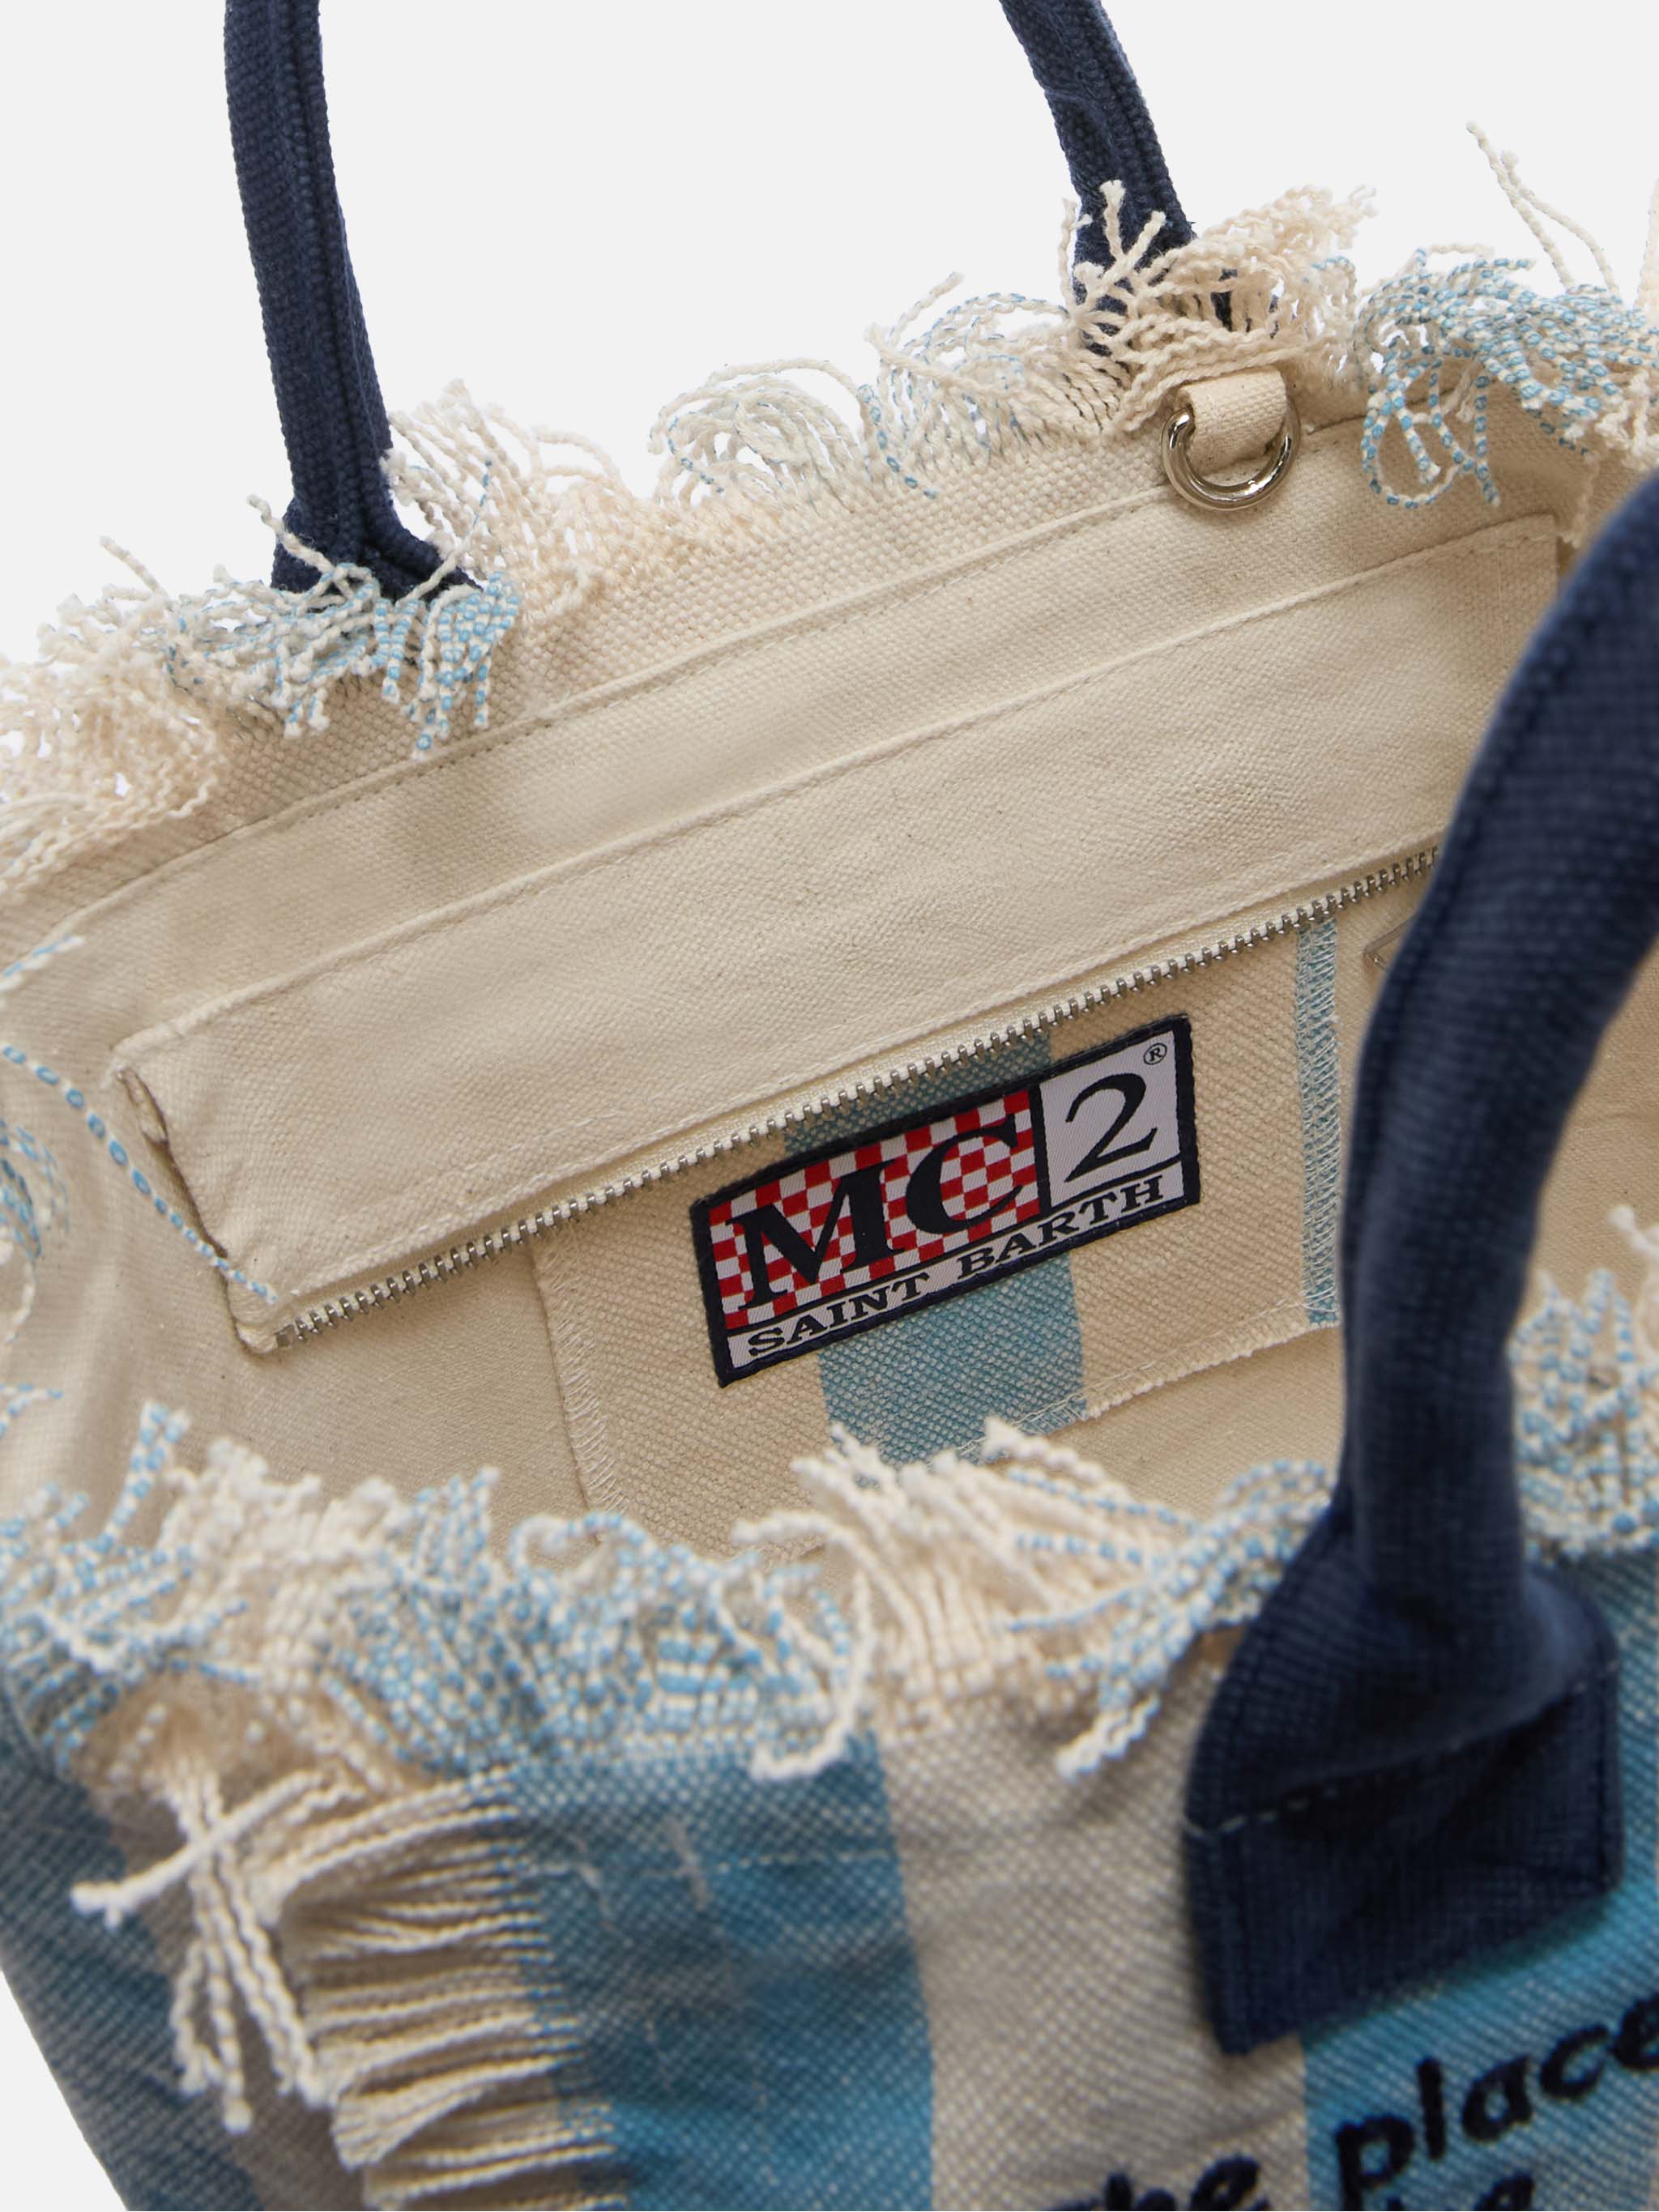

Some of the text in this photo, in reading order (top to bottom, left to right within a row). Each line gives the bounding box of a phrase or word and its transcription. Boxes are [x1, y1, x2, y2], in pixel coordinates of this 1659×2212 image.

[747, 1174, 1164, 1357] SAINT BARTH
[1335, 1993, 1659, 2212] place
